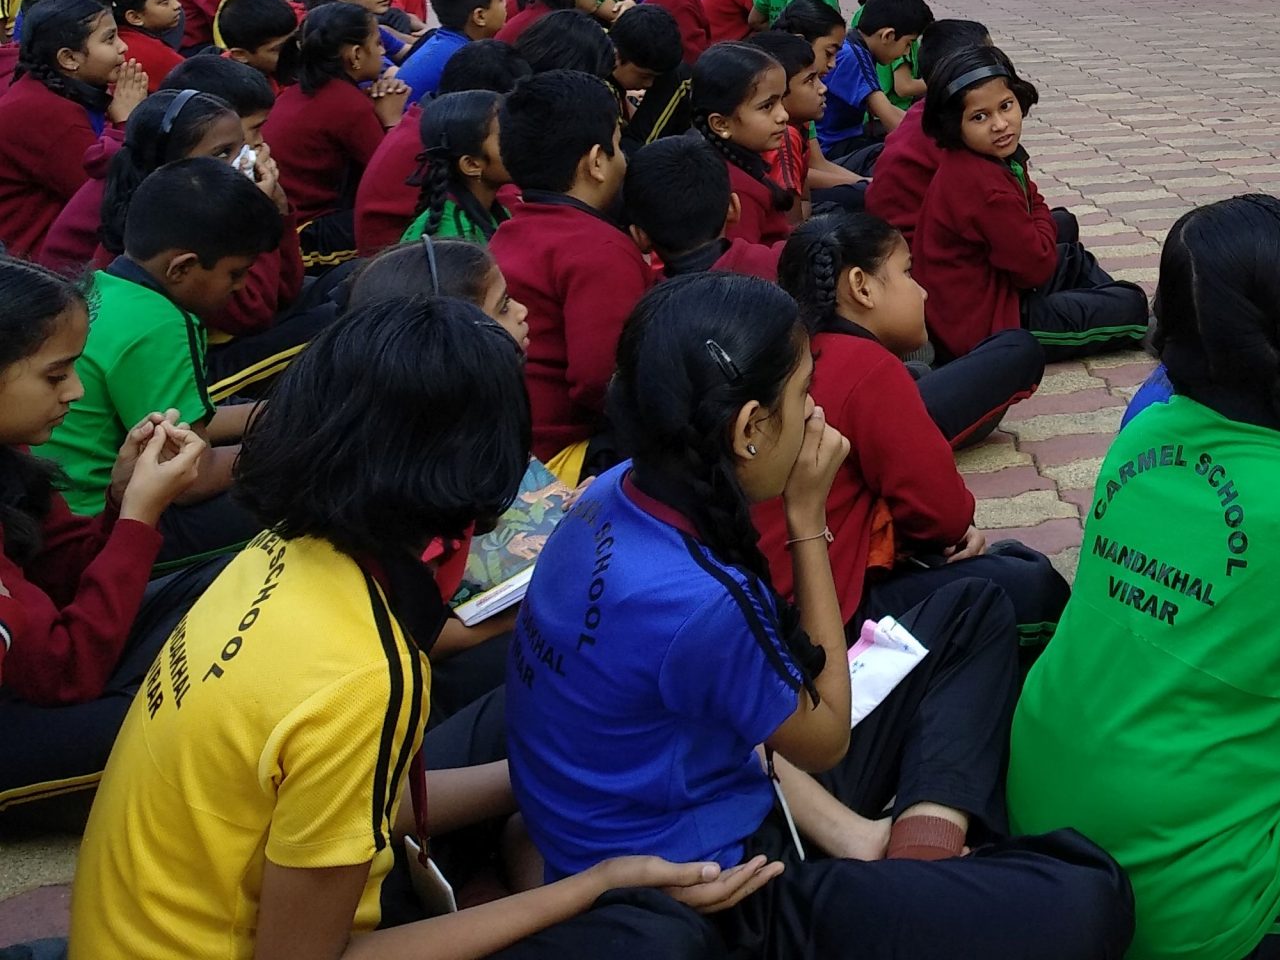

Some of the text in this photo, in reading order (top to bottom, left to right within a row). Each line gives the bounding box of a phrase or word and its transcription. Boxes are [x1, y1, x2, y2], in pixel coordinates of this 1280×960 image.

[1092, 534, 1216, 607] NANDAKHAL
[1094, 444, 1248, 577] CARMEL SCHOOL
[202, 545, 286, 682] SCHOOL
[576, 521, 614, 652] SCHOOL
[1106, 575, 1179, 626] VIRAR
